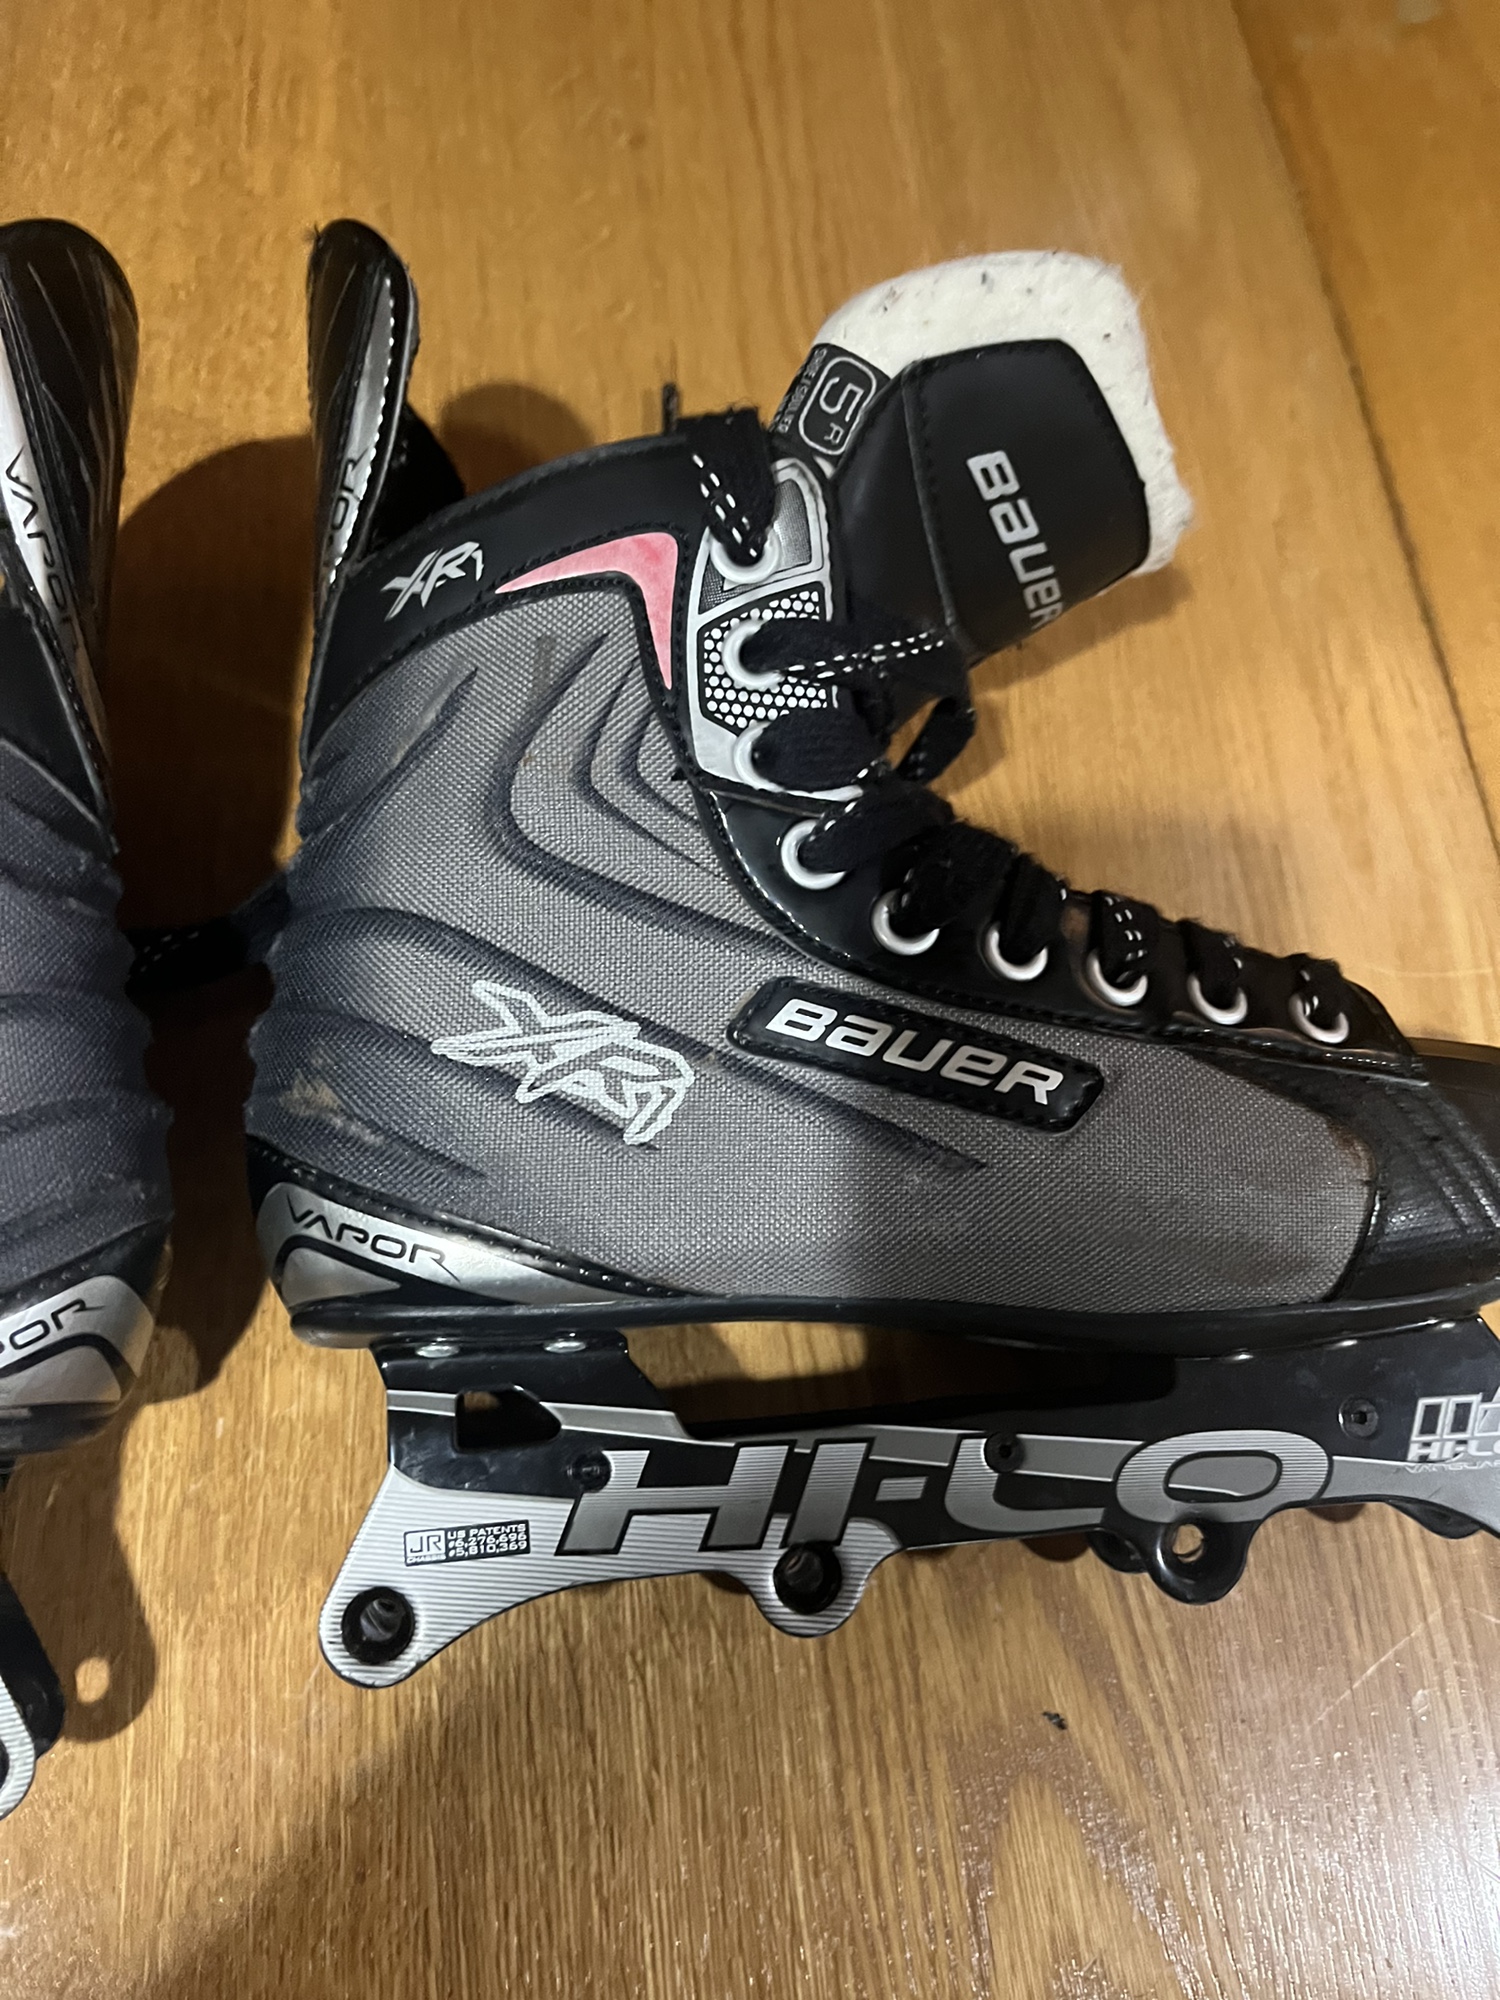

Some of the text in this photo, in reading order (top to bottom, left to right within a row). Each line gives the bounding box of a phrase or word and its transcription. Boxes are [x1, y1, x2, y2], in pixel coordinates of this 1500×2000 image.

[286, 1194, 461, 1283] VAPOR
[0, 1298, 105, 1355] OR
[409, 1534, 442, 1553] JR
[447, 1523, 526, 1540] US PATENTS
